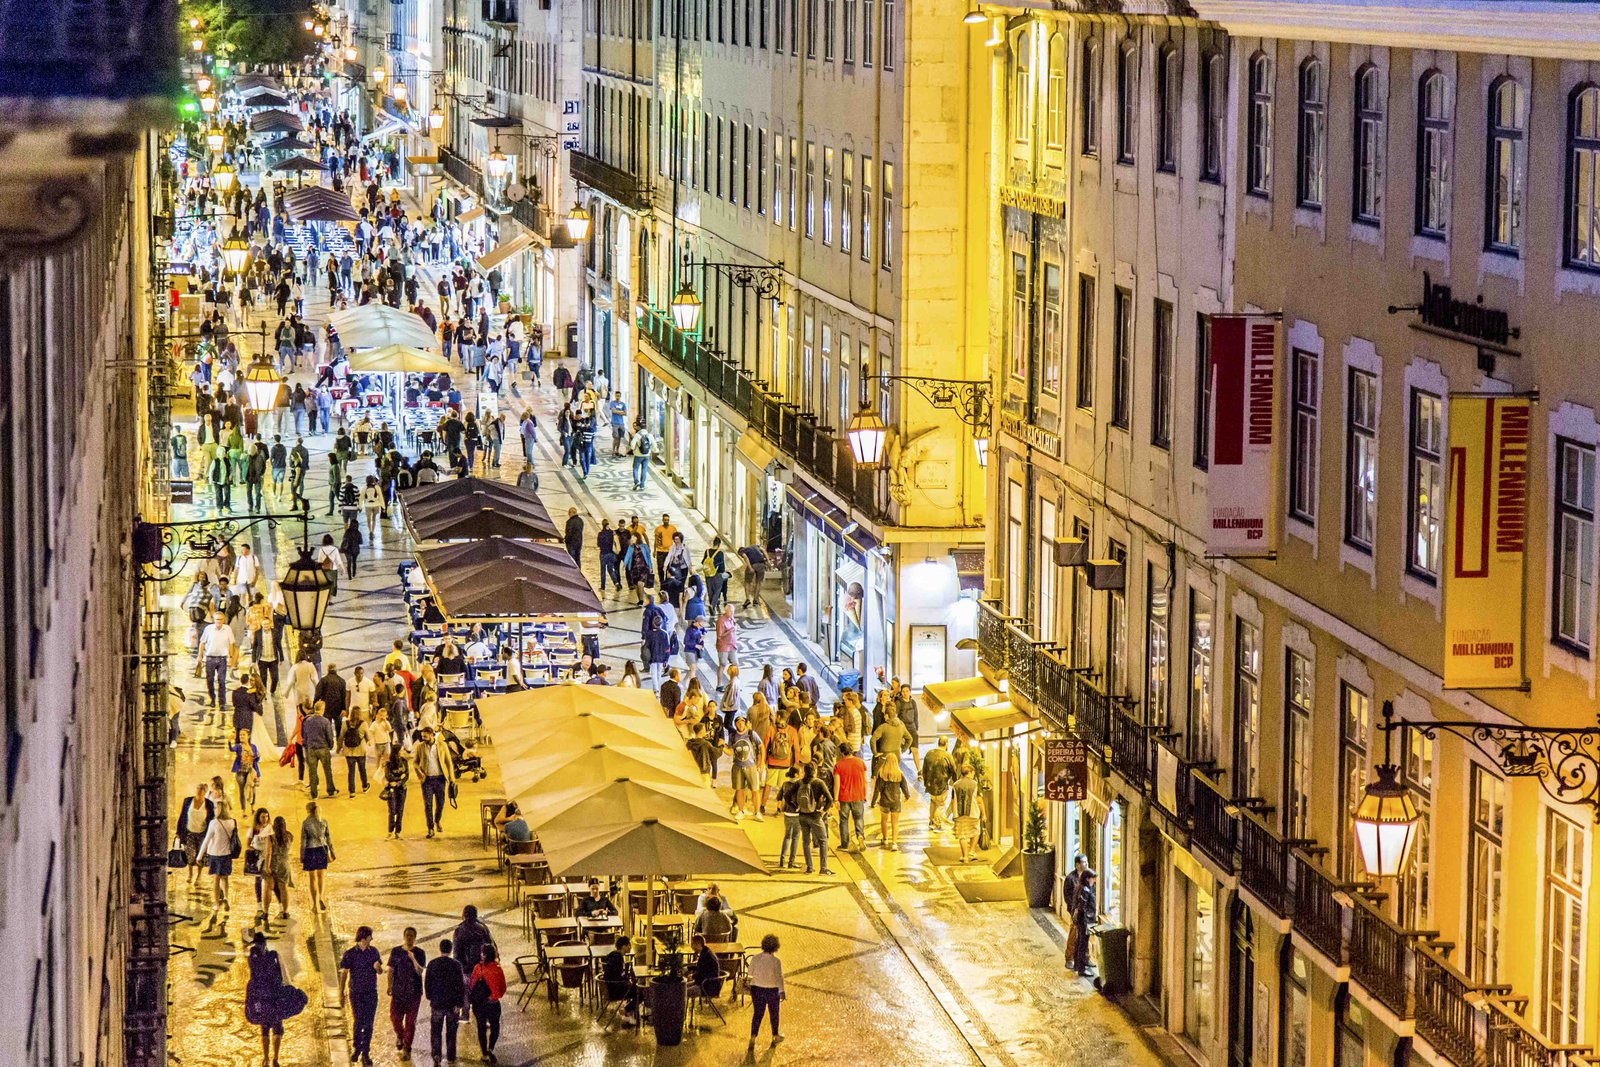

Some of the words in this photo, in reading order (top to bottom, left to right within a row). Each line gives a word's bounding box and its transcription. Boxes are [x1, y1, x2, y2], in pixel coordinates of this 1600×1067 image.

[1249, 324, 1275, 445] MILLENNIUM
[1496, 406, 1529, 553] MILLENNIUM
[1212, 518, 1263, 528] MILLENNIUM
[1247, 529, 1263, 539] BCP
[1452, 642, 1513, 655] MILLENNIUM
[1494, 656, 1513, 668] BCP
